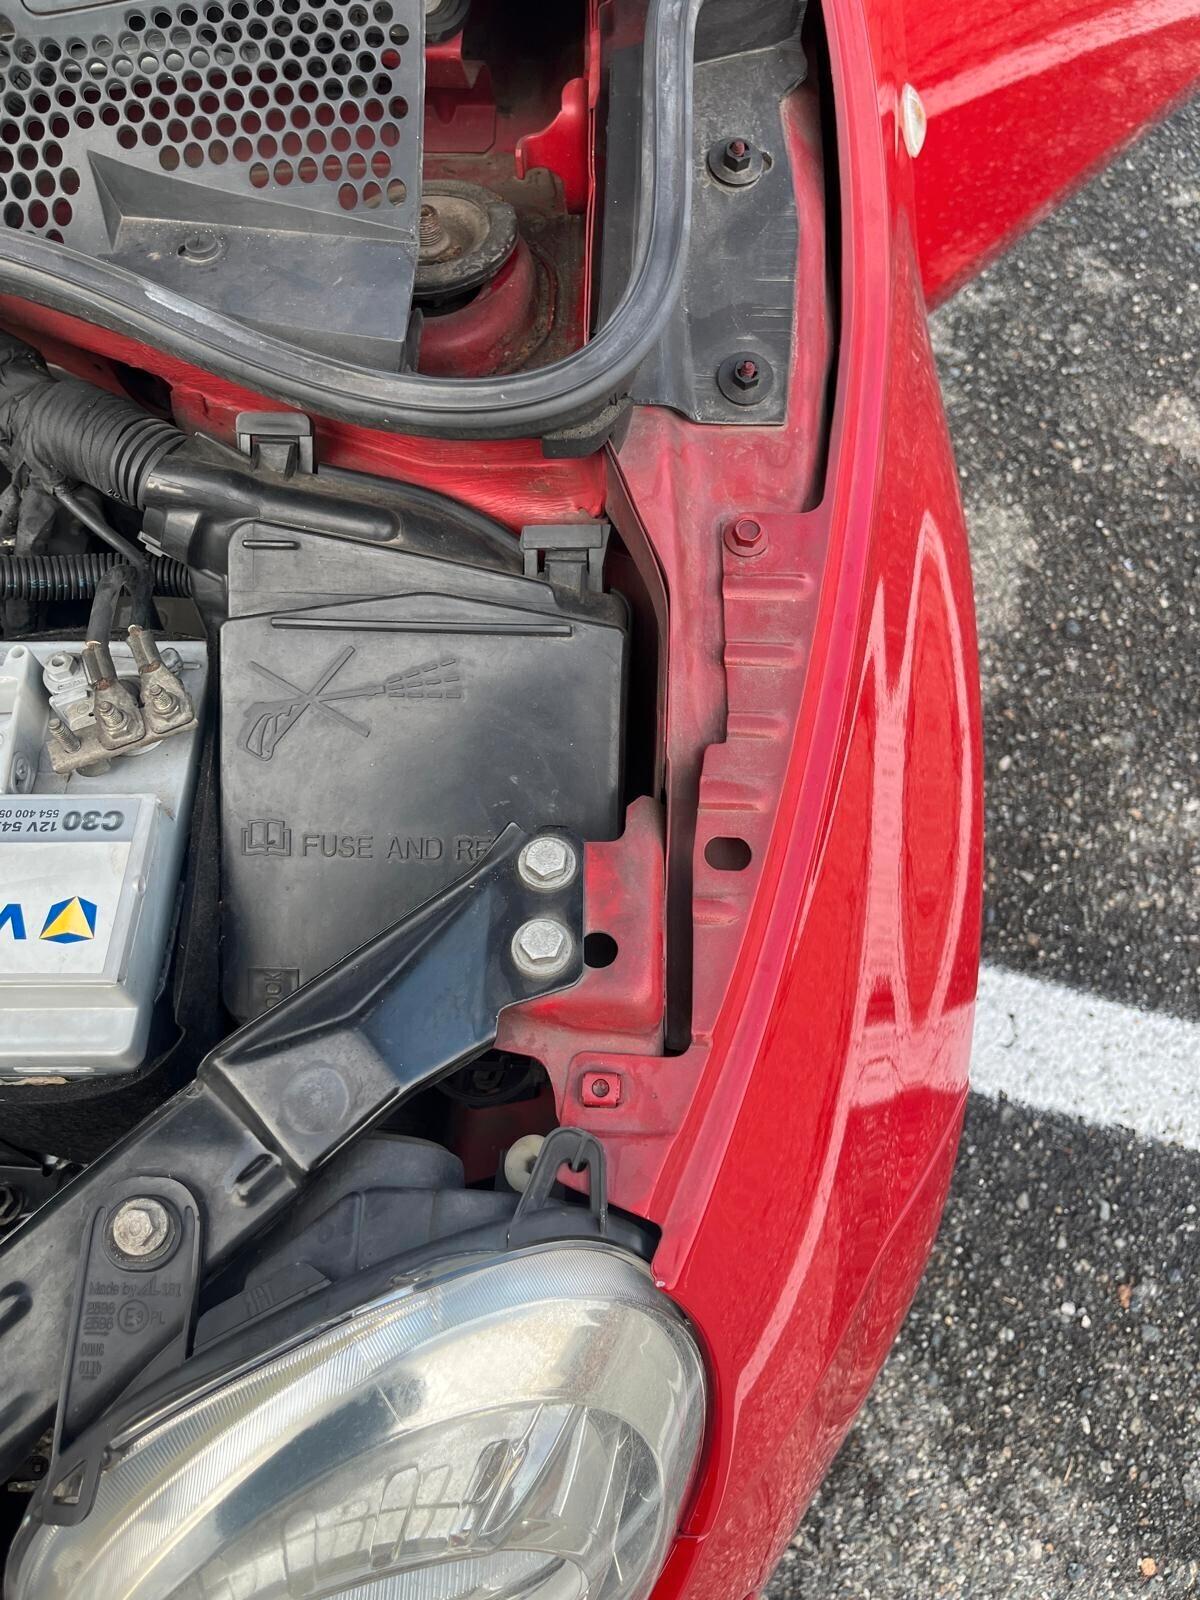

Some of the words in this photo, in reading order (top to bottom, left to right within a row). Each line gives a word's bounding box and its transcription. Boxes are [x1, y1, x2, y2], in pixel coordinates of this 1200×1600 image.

[15, 809, 36, 818] 400
[38, 809, 60, 818] 554
[0, 821, 23, 832] 54
[26, 820, 57, 832] 12V
[62, 810, 125, 832] C30
[302, 834, 373, 859] FUSE
[386, 836, 443, 860] AND
